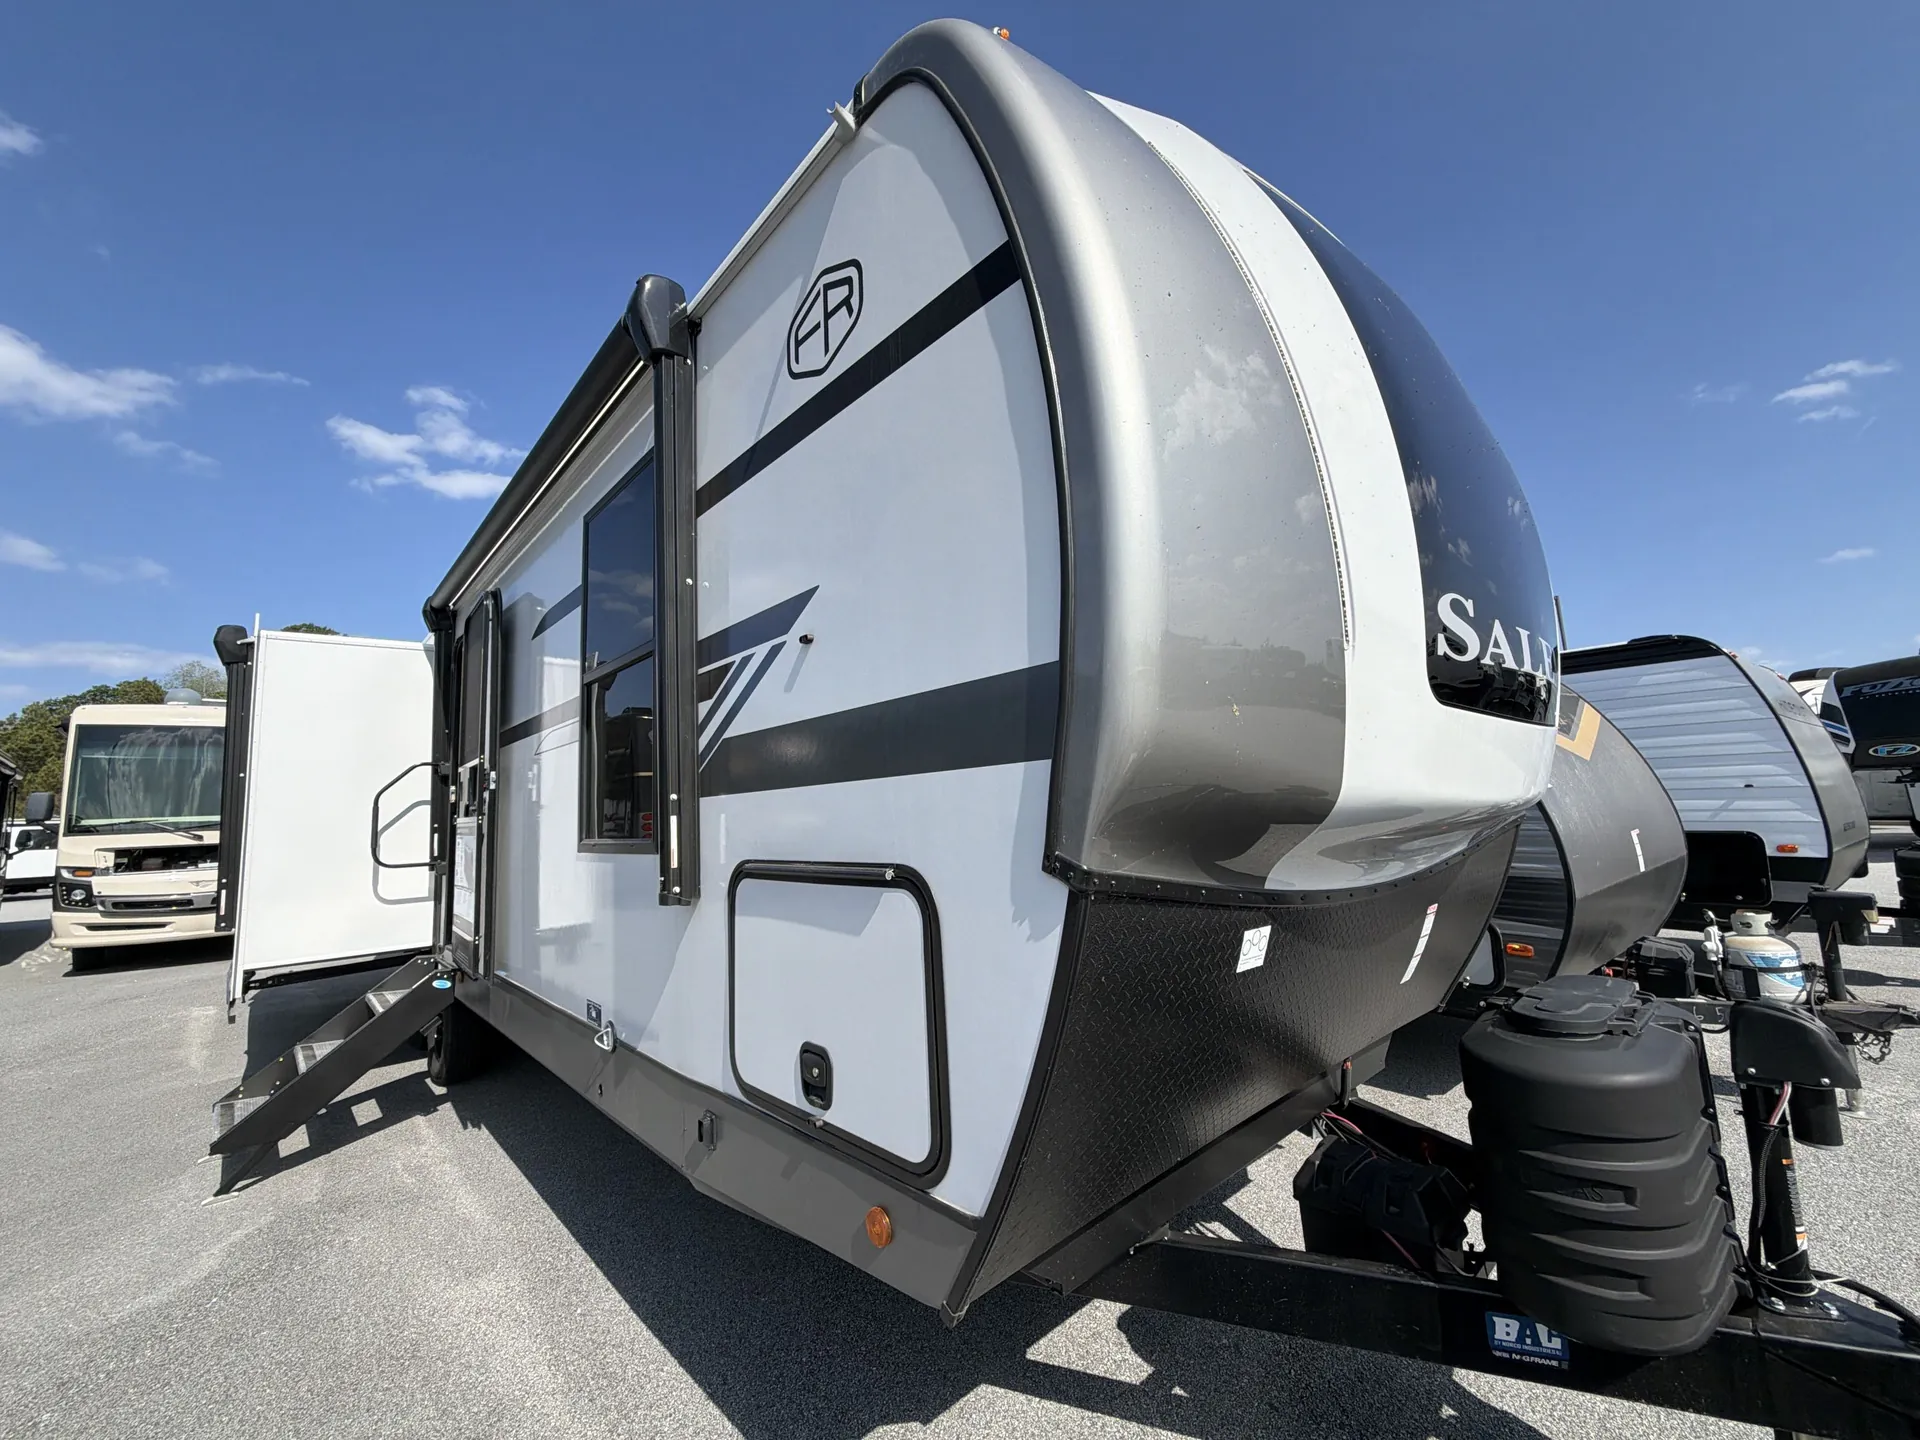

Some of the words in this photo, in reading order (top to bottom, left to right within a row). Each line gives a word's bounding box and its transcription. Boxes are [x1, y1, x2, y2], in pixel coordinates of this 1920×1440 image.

[794, 275, 854, 365] FR
[1877, 743, 1912, 756] FZ
[1501, 1341, 1522, 1349] NORCO
